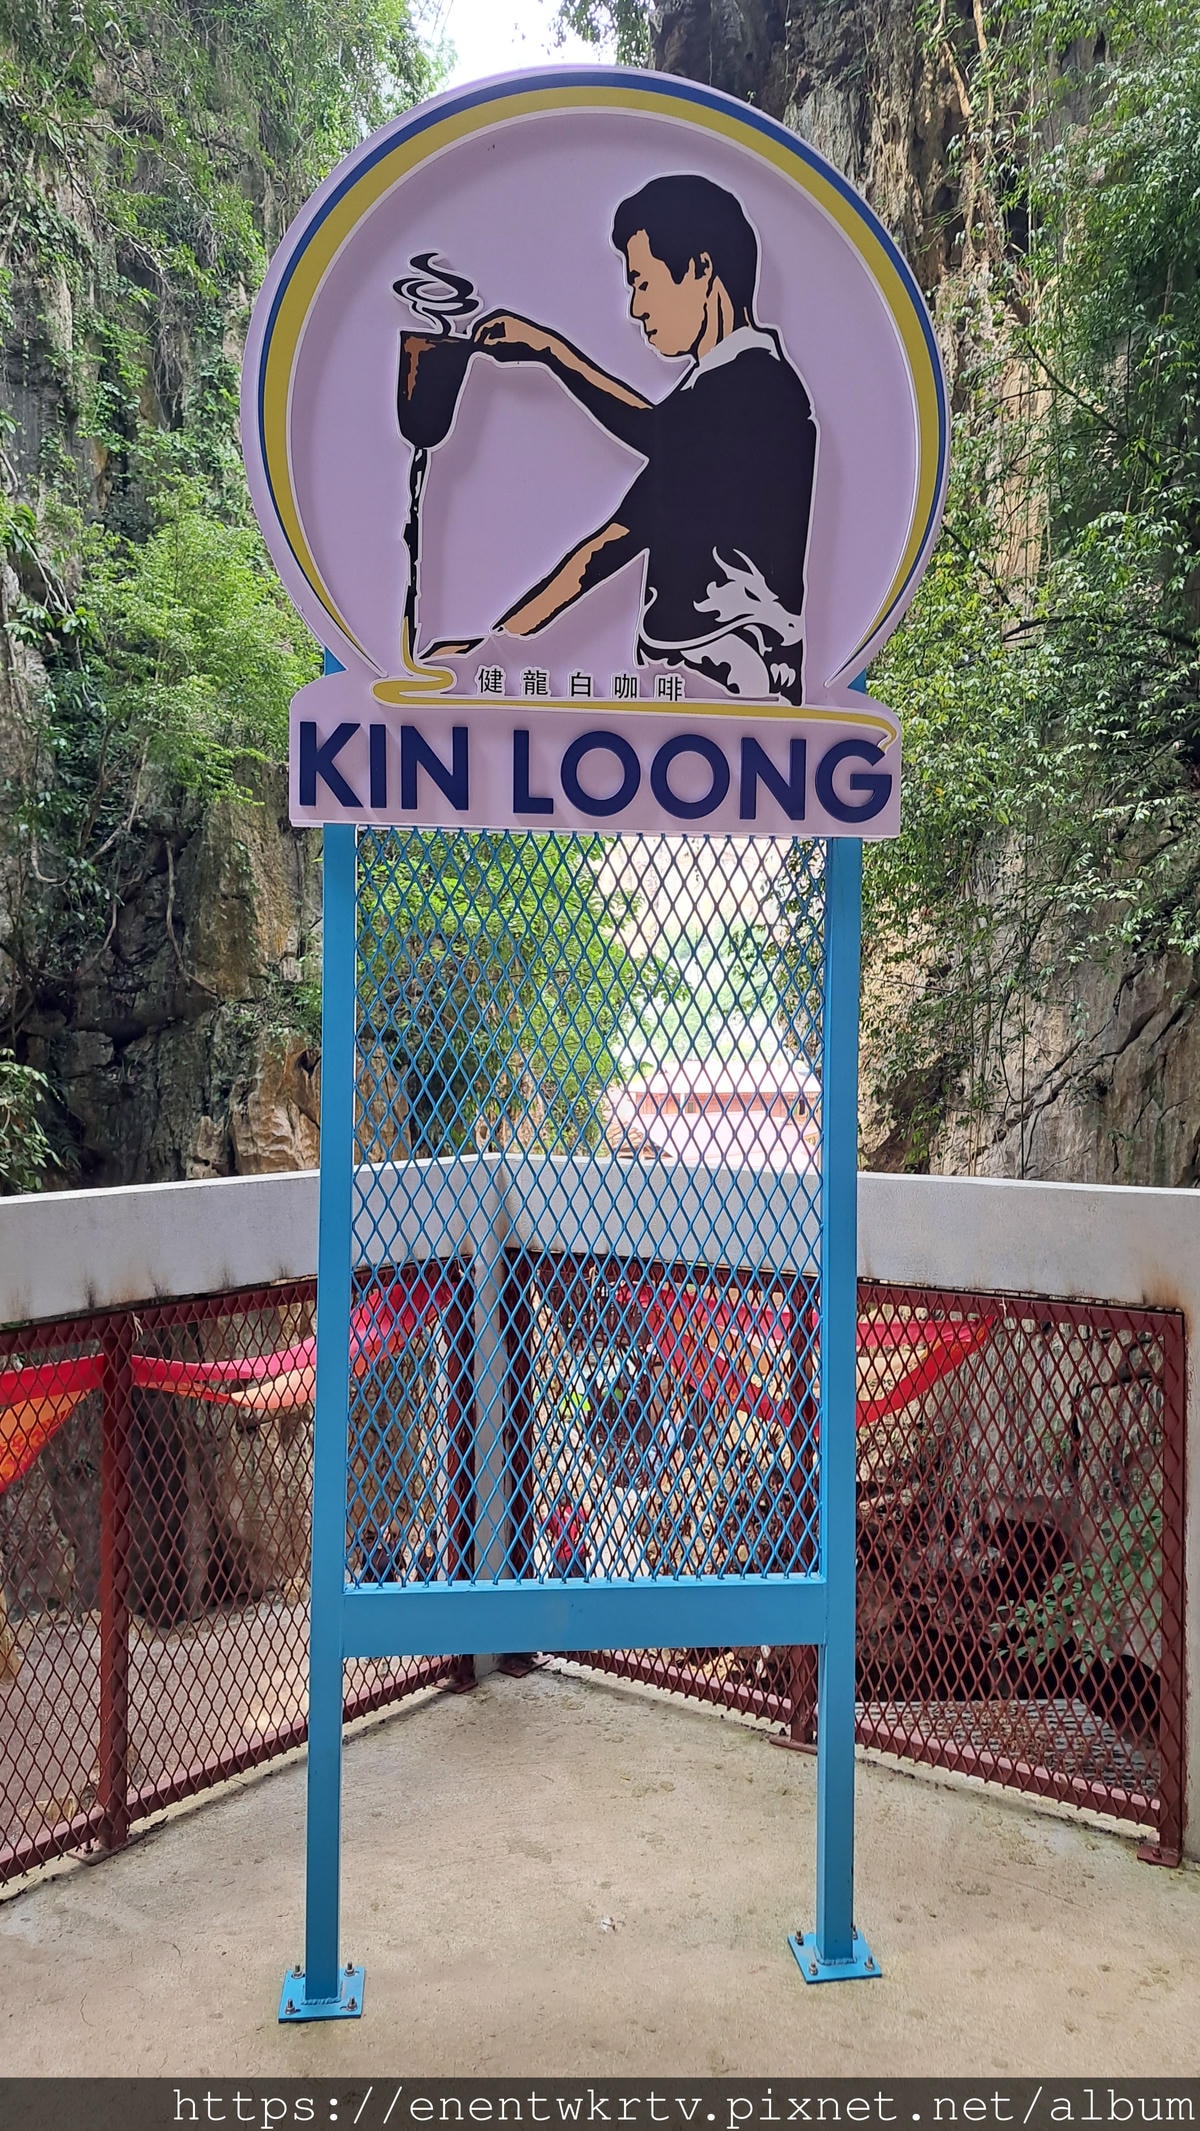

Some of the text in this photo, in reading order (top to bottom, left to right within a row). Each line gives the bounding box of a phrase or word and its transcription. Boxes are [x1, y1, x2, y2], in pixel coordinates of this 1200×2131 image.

[478, 667, 684, 702] 健龍白咖啡
[300, 722, 892, 823] KIN LOONG
